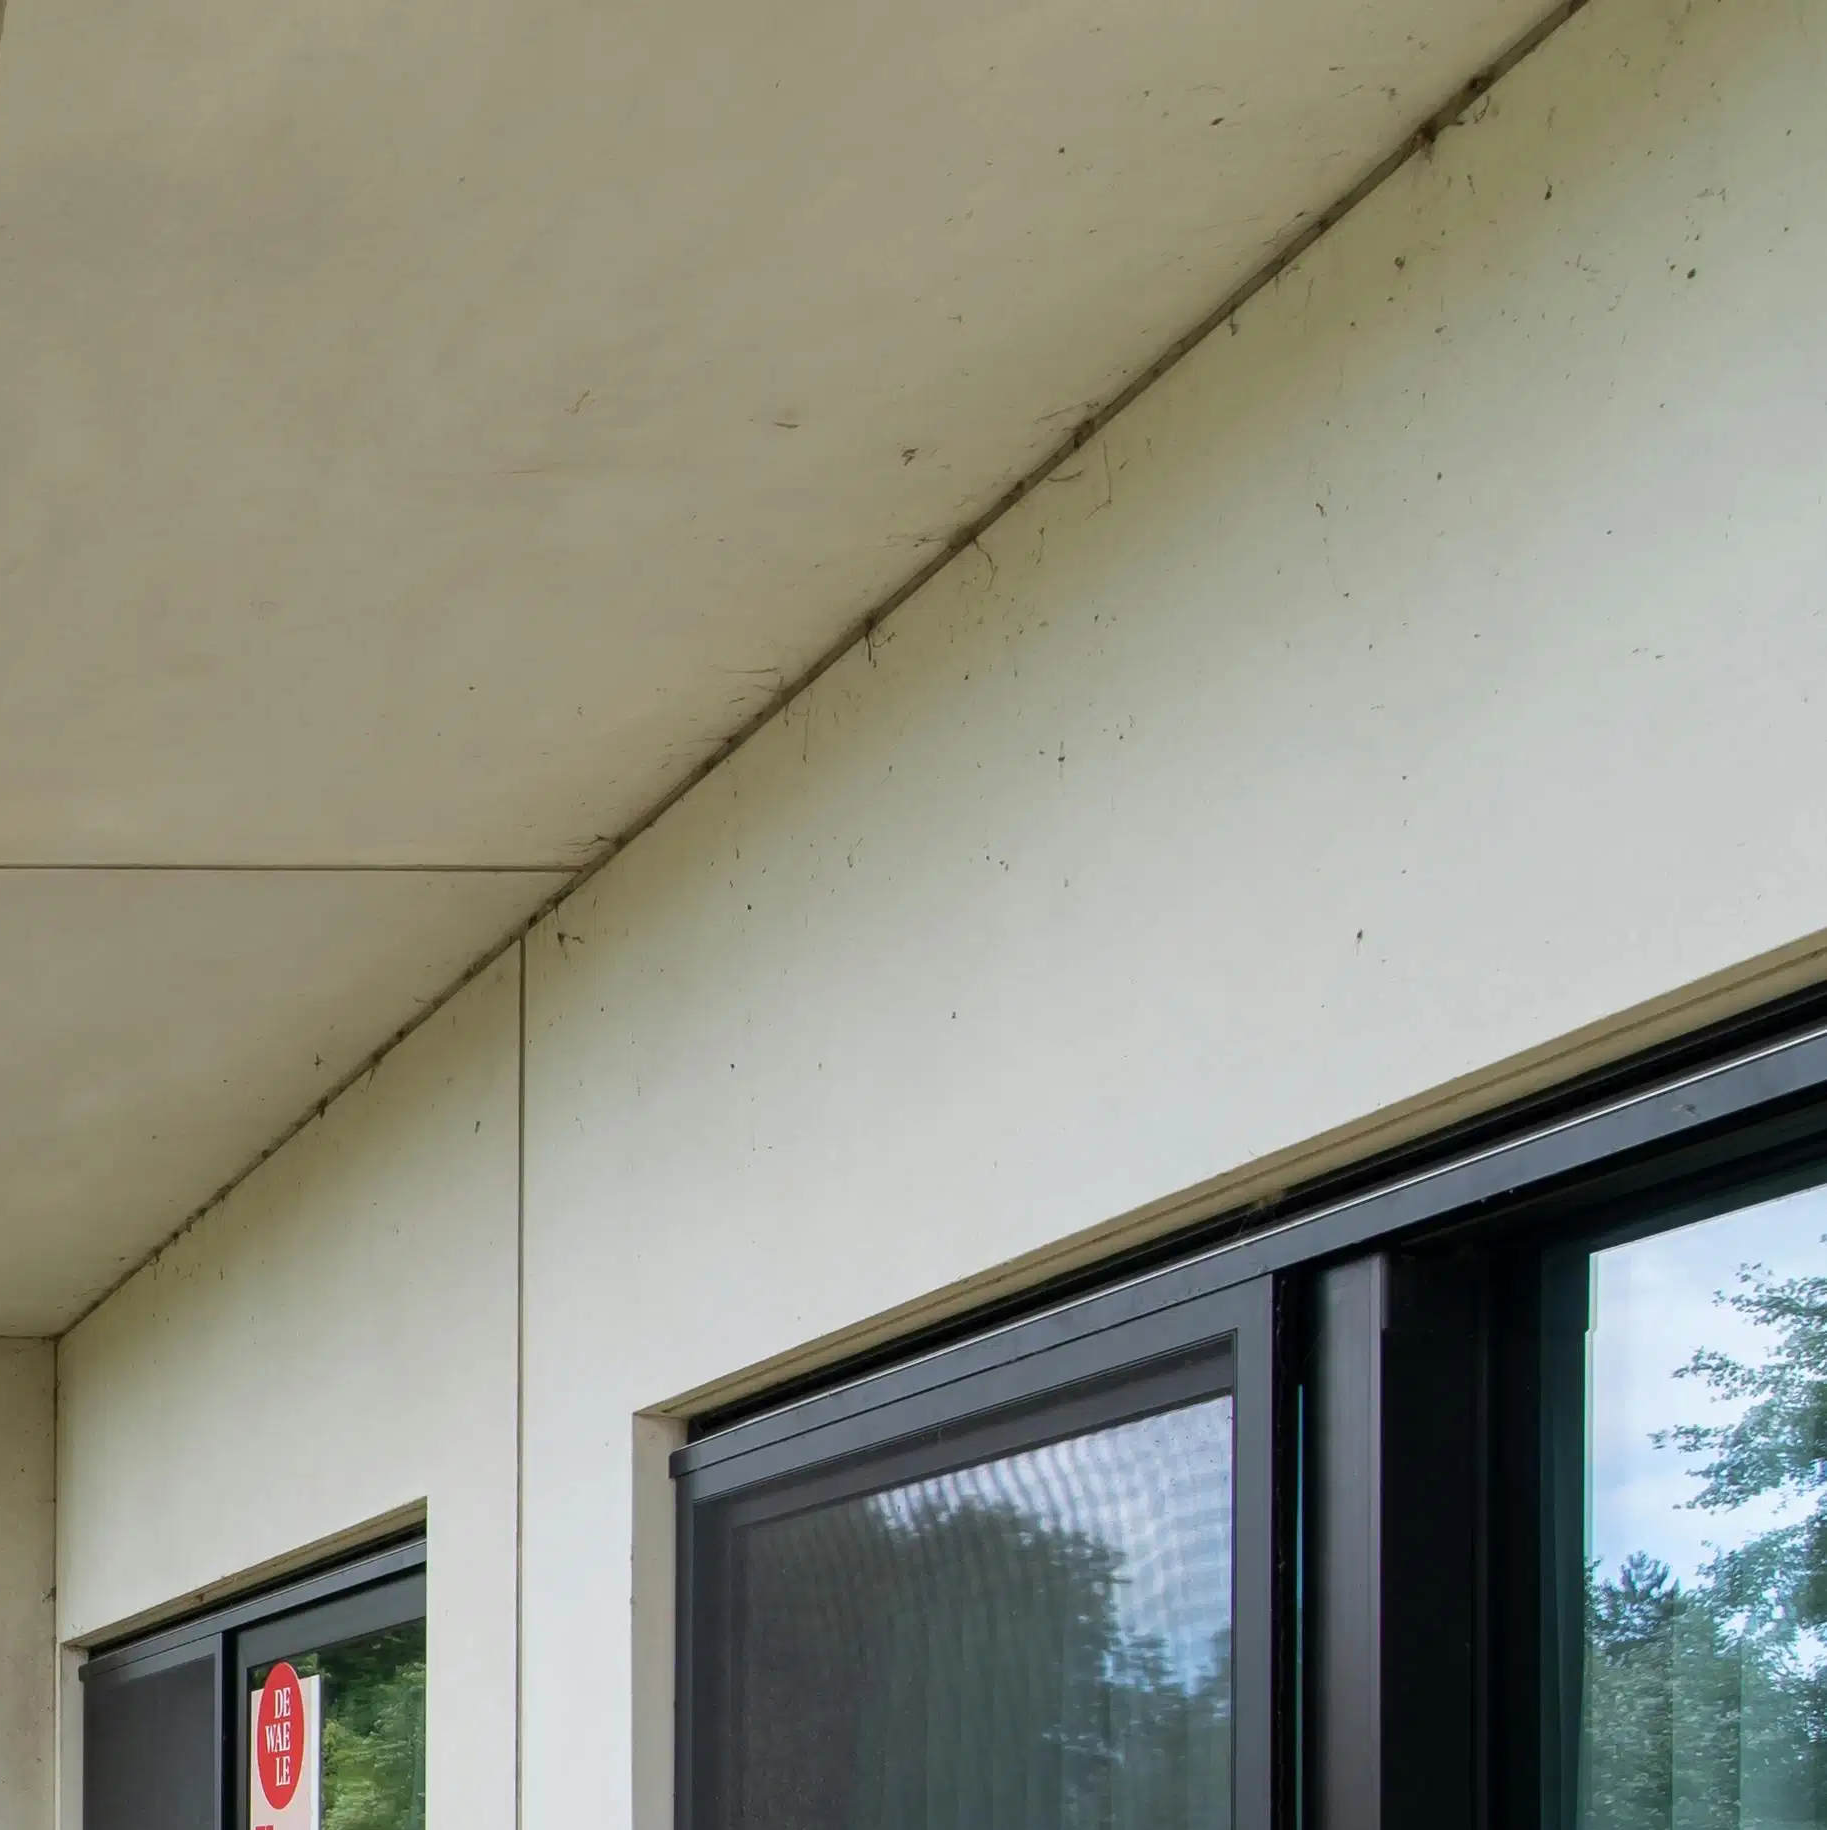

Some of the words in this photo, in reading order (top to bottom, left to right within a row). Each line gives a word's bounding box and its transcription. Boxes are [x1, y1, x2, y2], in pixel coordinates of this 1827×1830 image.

[274, 1687, 291, 1719] DE
[265, 1721, 291, 1753] WAE
[276, 1756, 291, 1786] LE
